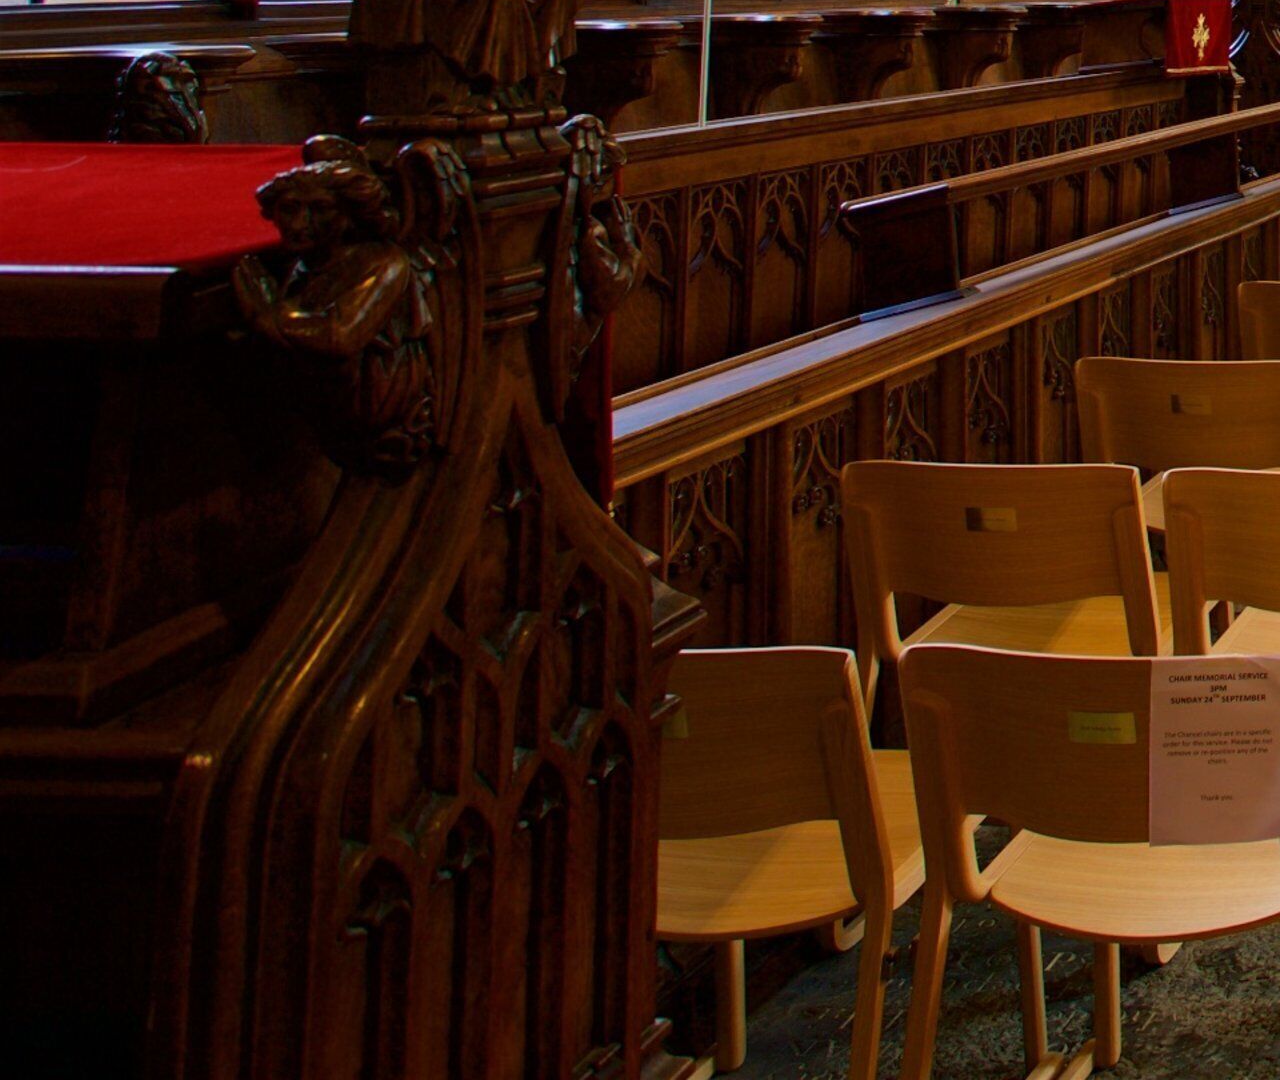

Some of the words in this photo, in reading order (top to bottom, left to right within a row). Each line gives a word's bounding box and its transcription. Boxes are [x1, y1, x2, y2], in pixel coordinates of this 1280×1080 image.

[1168, 675, 1192, 683] CHAIR
[1193, 673, 1237, 682] MEMORIAL
[1238, 672, 1269, 680] SERVICE
[1221, 694, 1267, 703] SEPTEMBER
[1164, 731, 1176, 739] The
[1177, 730, 1203, 738] Chancel
[1203, 729, 1222, 737] chairs
[1247, 728, 1272, 737] specific
[1162, 740, 1182, 748] order
[1182, 739, 1191, 747] for
[1231, 737, 1251, 745] Please
[1252, 737, 1260, 745] do
[1262, 737, 1273, 745] not
[1166, 749, 1192, 757] remove
[1200, 748, 1236, 757] re-position
[1236, 748, 1248, 756] any
[1249, 747, 1257, 755] of
[1201, 793, 1220, 801] Thank
